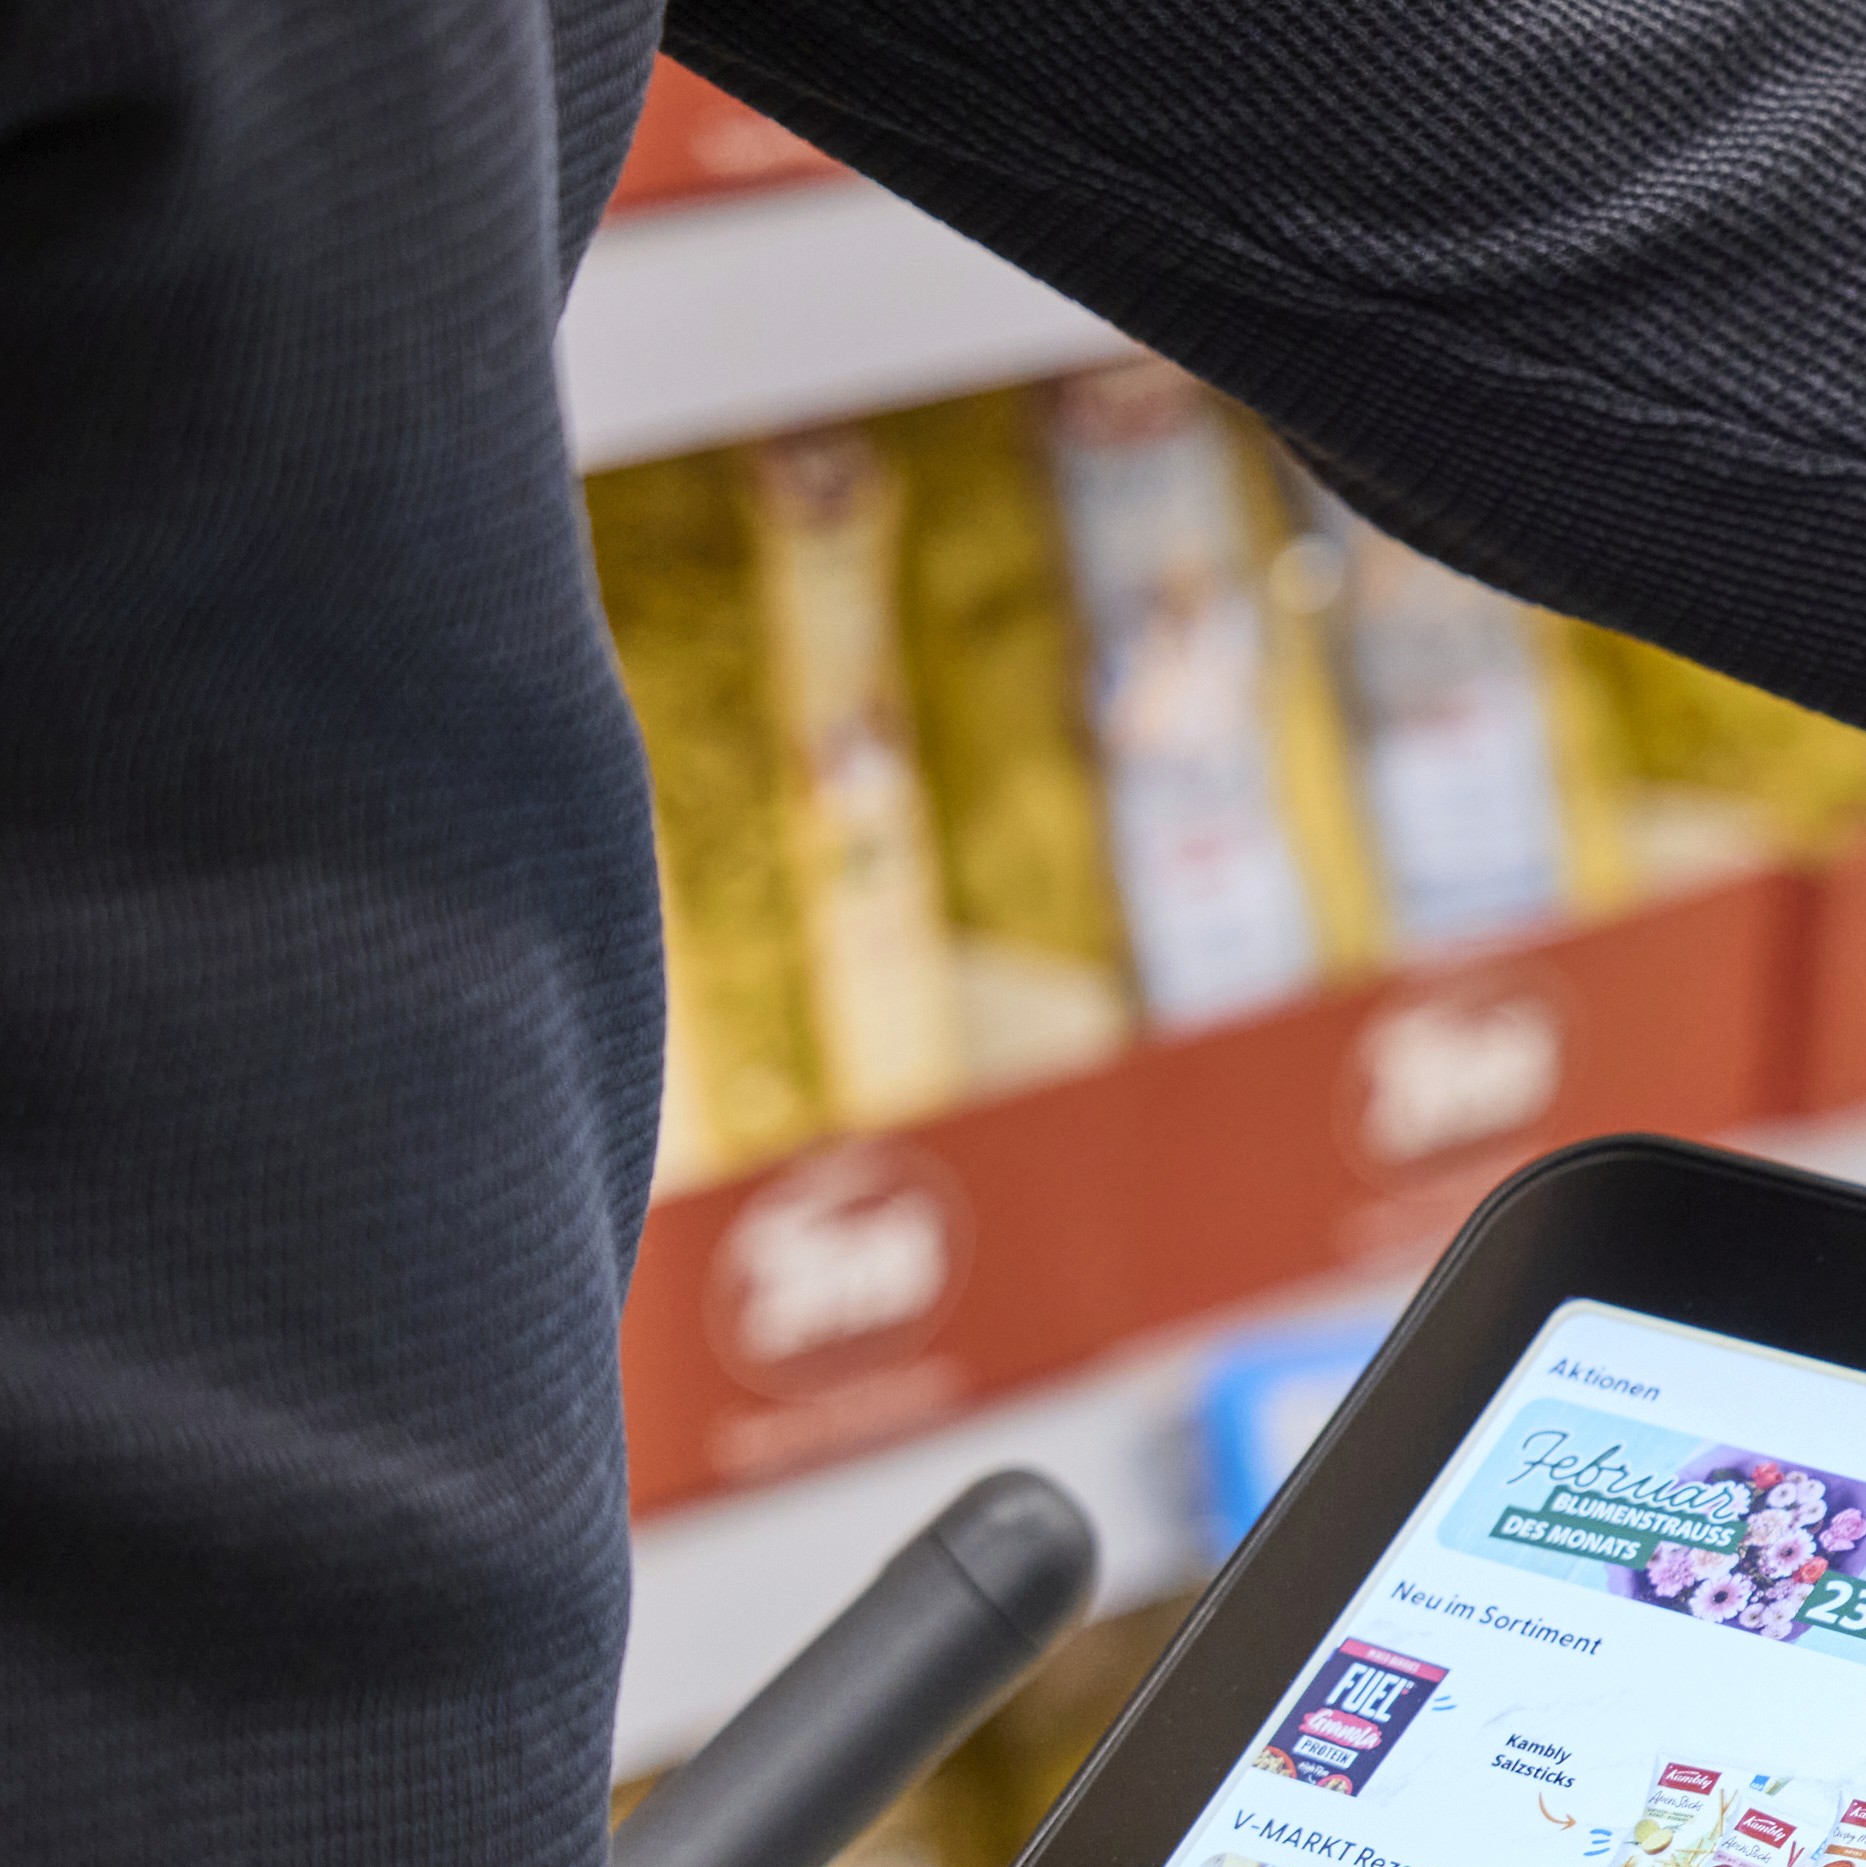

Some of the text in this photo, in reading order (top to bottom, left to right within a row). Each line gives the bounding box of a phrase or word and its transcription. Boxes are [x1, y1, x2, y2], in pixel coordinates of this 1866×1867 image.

[1548, 1356, 1661, 1401] Aktionen
[1507, 1429, 1745, 1523] Februar
[1501, 1513, 1642, 1562] DES MONATS
[1550, 1491, 1736, 1547] BLUMENSTRAUSS
[1390, 1579, 1604, 1657] Neu im Sortiment
[1326, 1662, 1405, 1723] FUEL
[1491, 1753, 1577, 1792] Salzsticks
[1505, 1732, 1573, 1767] Kambly
[1666, 1769, 1713, 1791] Kambly
[1232, 1809, 1358, 1863] V-MARKT
[1743, 1816, 1786, 1842] Kambly
